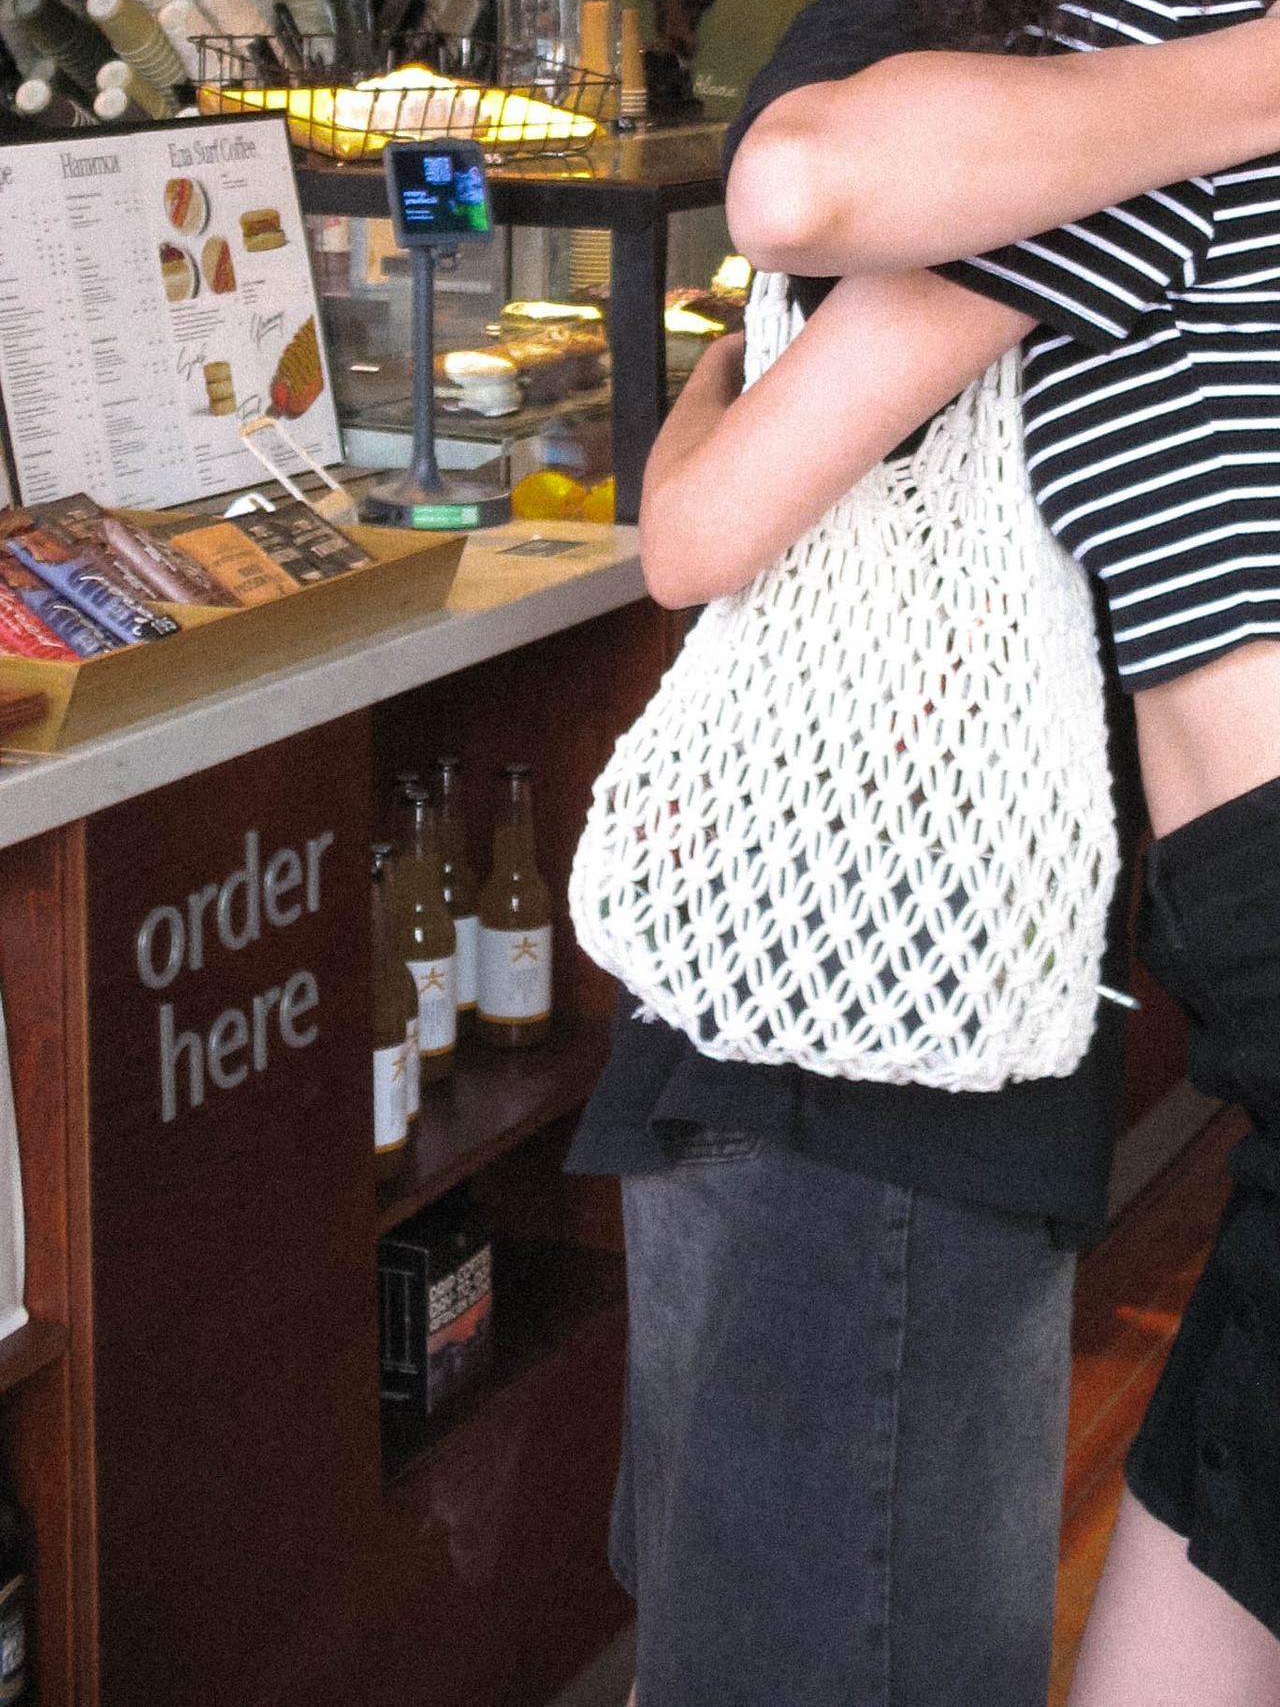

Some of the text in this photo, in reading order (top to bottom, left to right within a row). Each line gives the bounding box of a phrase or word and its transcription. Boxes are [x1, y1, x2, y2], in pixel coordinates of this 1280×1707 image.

[219, 136, 257, 162] Coffee
[136, 830, 335, 991] order
[158, 970, 319, 1123] here
